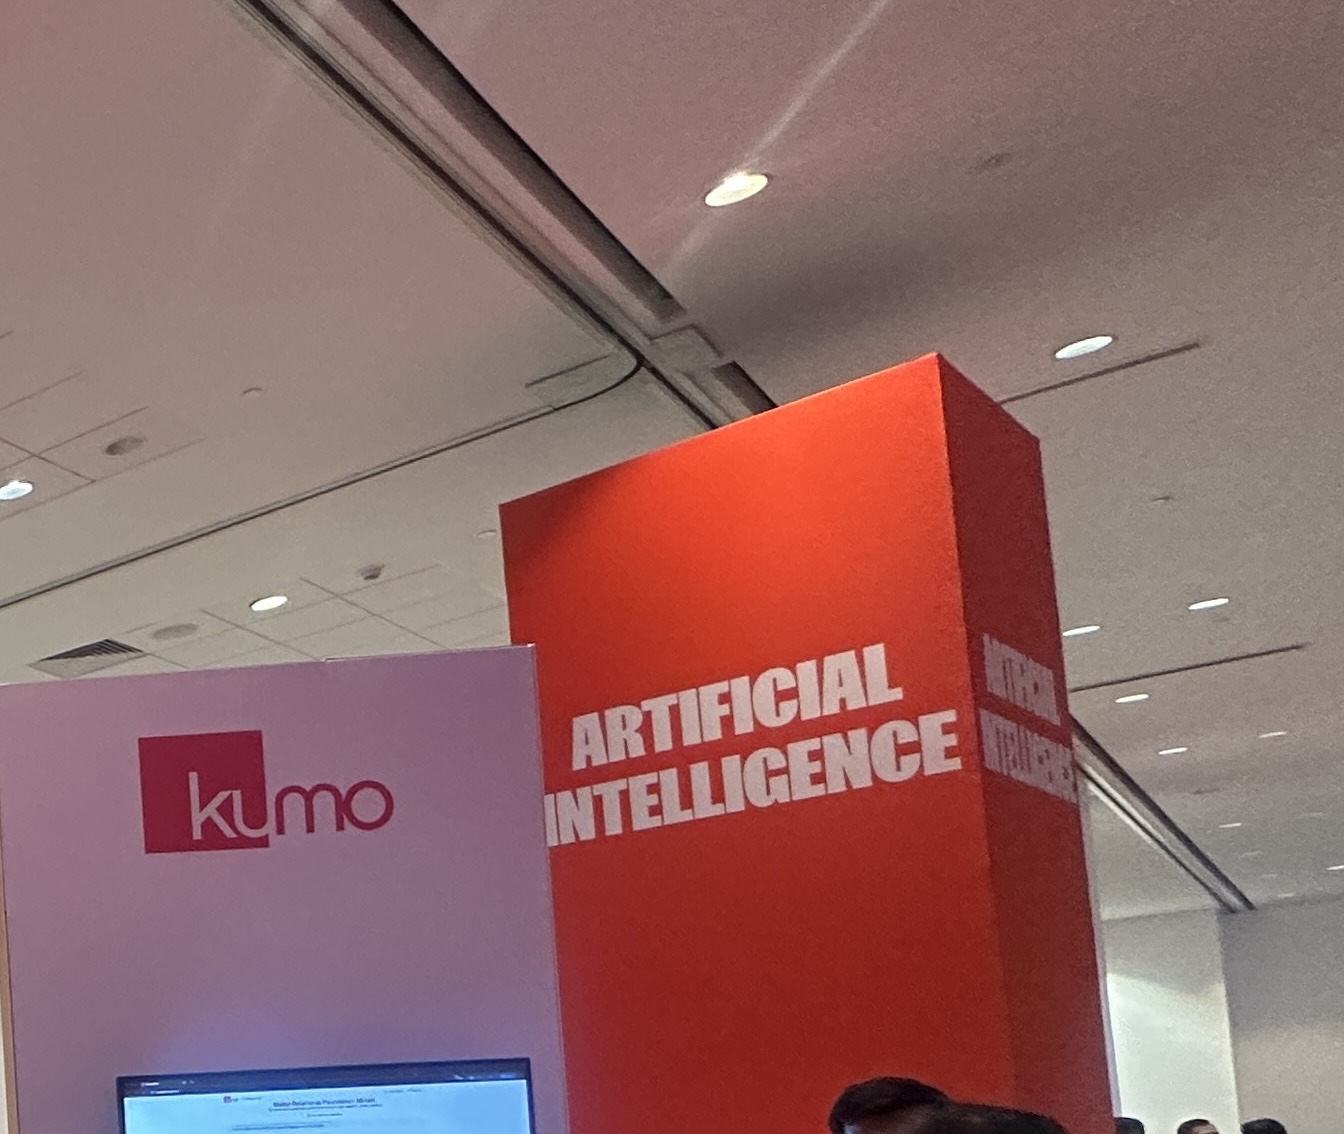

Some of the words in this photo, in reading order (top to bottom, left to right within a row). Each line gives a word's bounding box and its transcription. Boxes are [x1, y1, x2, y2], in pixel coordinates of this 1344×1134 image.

[571, 643, 903, 771] ARTIFICIAL
[188, 771, 394, 840] kumo
[544, 709, 963, 848] INTELLIGENCE
